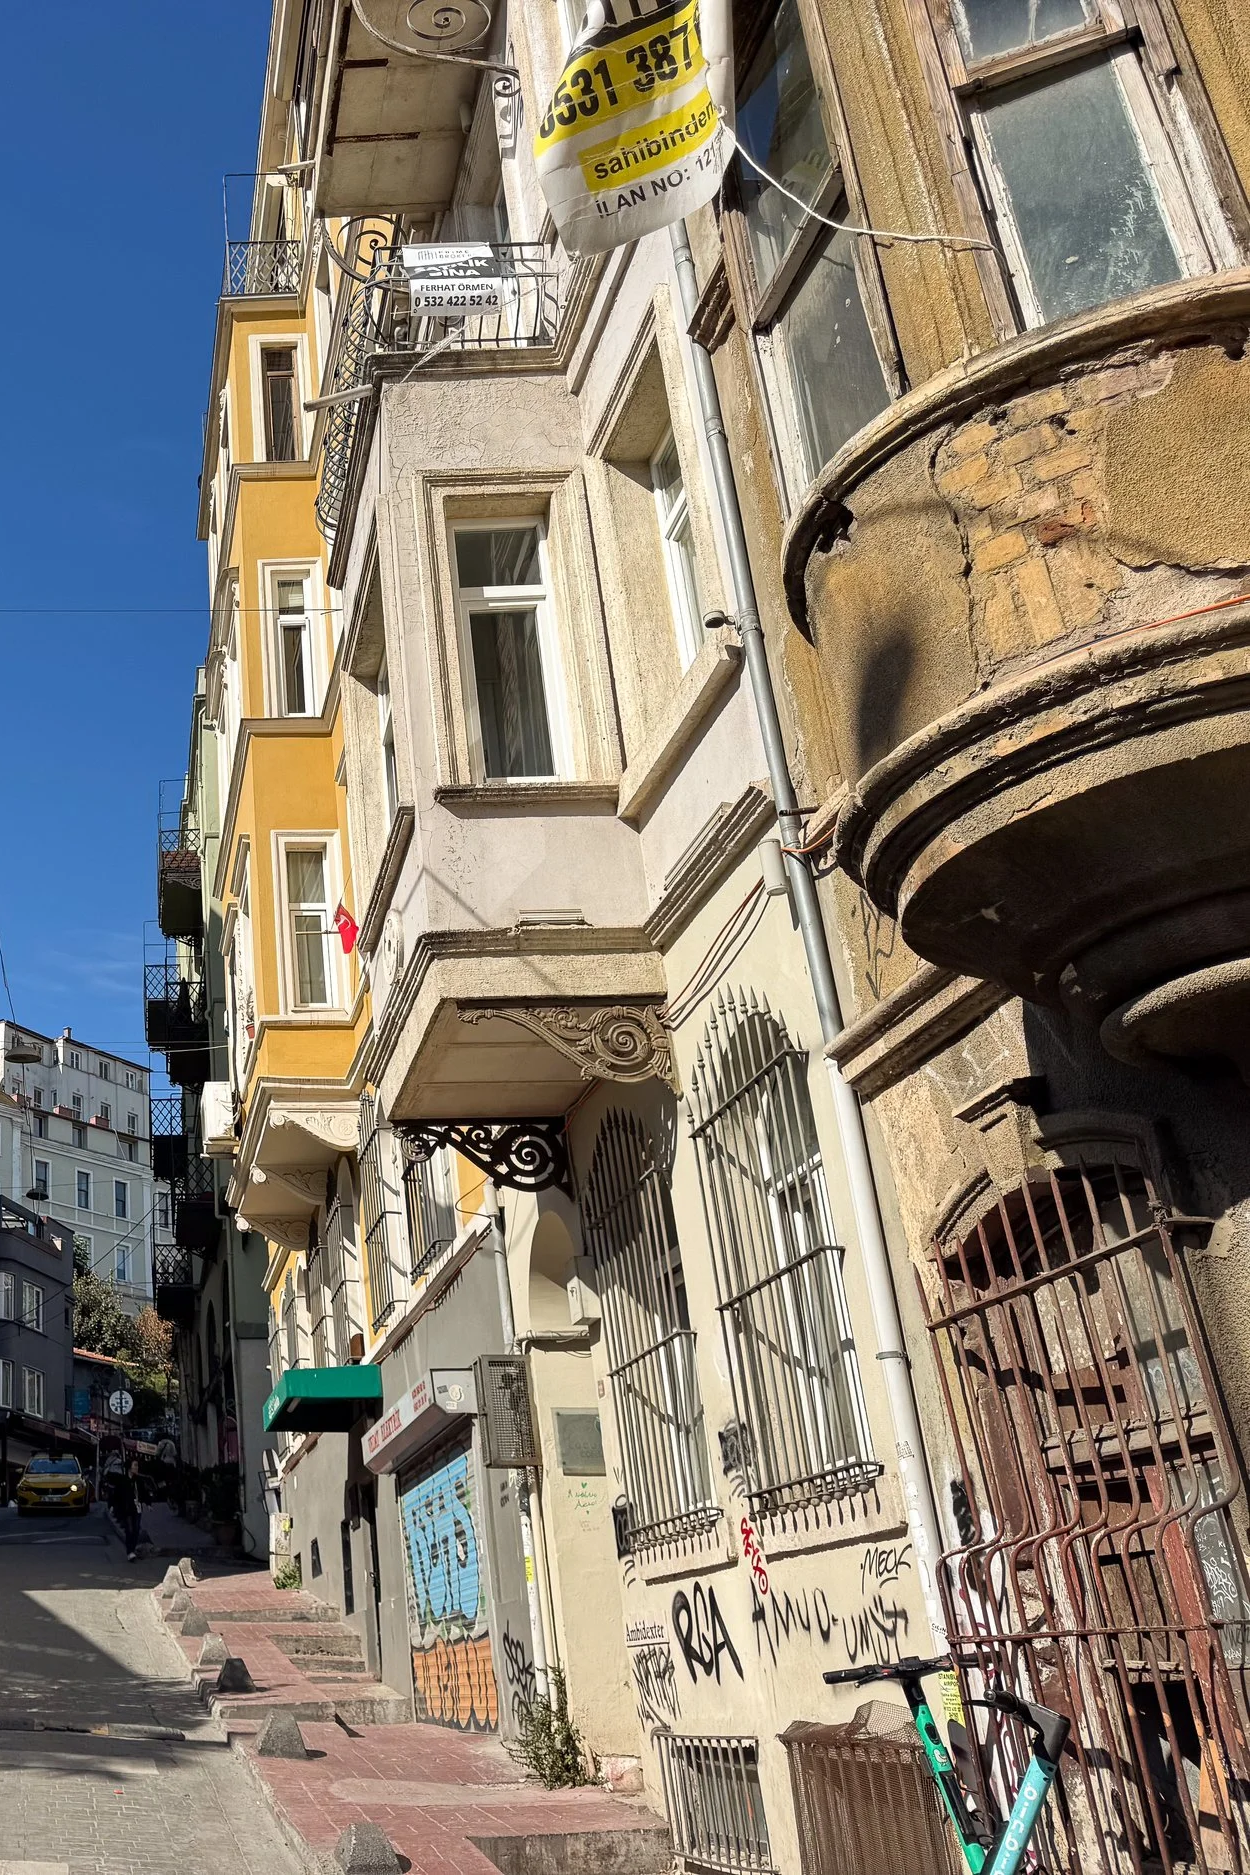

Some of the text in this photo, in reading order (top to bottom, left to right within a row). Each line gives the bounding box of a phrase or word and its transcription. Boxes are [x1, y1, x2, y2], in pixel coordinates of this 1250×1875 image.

[651, 167, 691, 196] NO:
[420, 283, 494, 292] FERHAT ÖRMEN
[414, 294, 498, 307] 0 532 422 52 42
[626, 1620, 665, 1642] Ambidexter
[993, 1782, 1038, 1875] binbi
